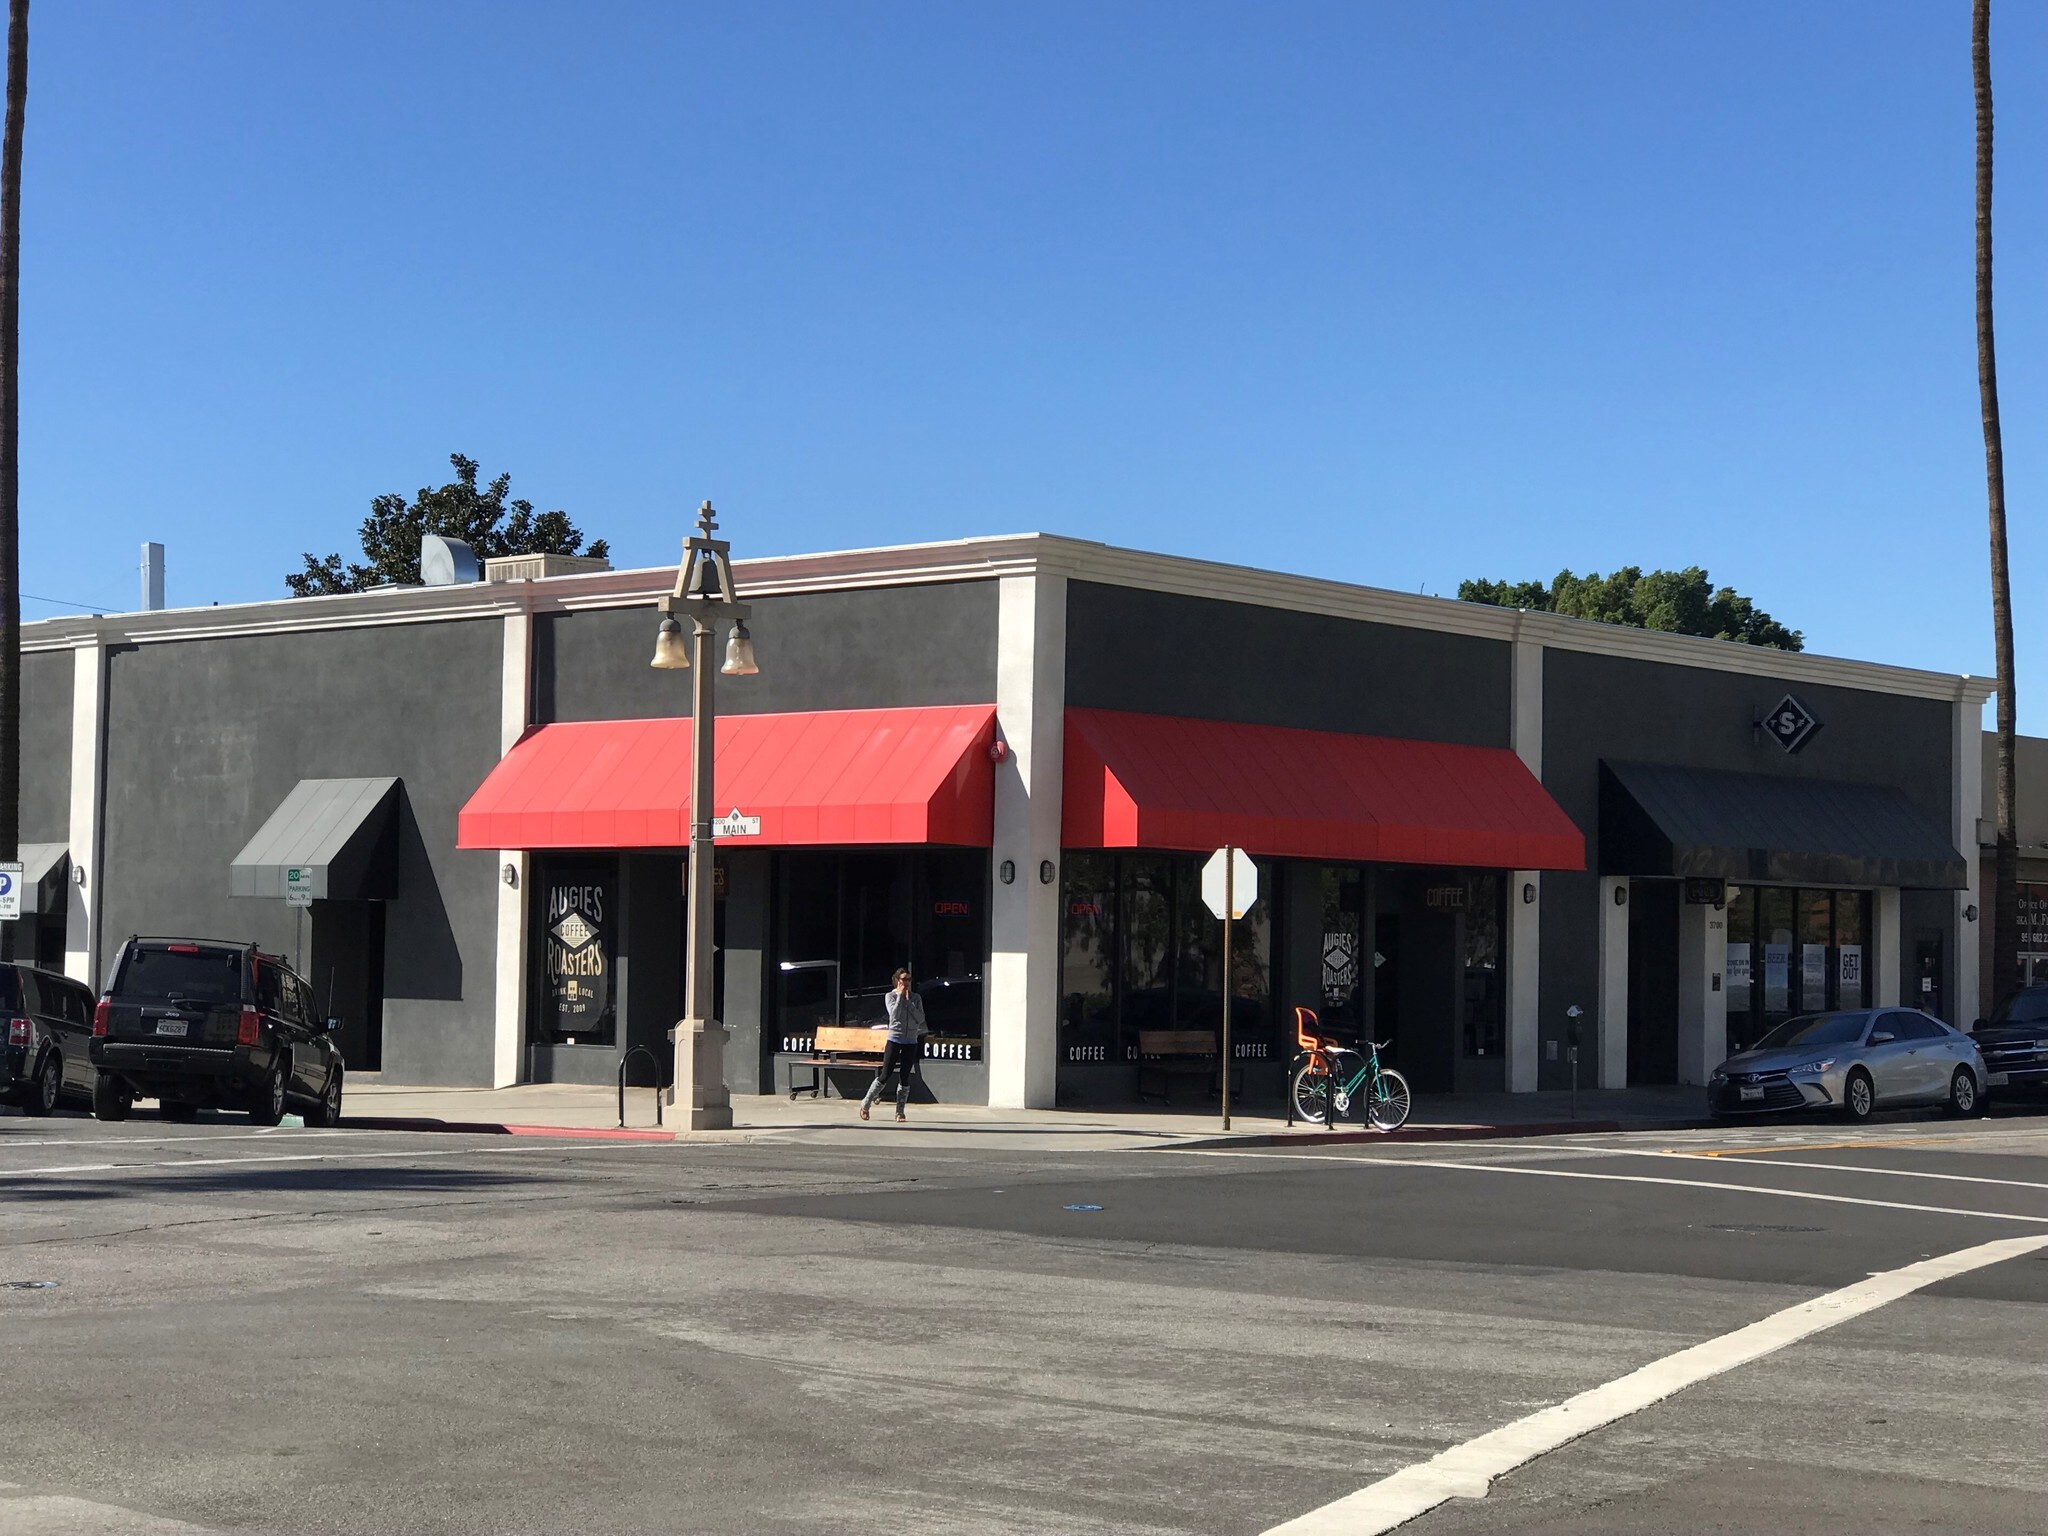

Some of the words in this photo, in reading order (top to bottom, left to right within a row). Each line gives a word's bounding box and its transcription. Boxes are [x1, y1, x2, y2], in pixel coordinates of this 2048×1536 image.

[1778, 711, 1796, 735] S
[723, 825, 747, 835] MAIN
[0, 862, 22, 871] ARKING
[289, 871, 299, 880] 20
[1426, 887, 1463, 907] COFFEE
[548, 886, 603, 924] AUGIES
[934, 902, 969, 914] OPEN
[1071, 903, 1102, 915] OPEN
[560, 923, 588, 937] COFFEE
[1323, 932, 1352, 955] AUGIES
[547, 937, 602, 986] ROASTERS
[1843, 954, 1859, 967] GET
[1321, 963, 1352, 992] ROASTERS
[1842, 967, 1859, 980] OUT
[578, 987, 594, 999] LOCAL
[558, 1003, 570, 1013] EST.
[783, 1036, 817, 1052] COFF
[924, 1042, 971, 1060] COFFEE
[1235, 1043, 1267, 1058] COFFEE
[1069, 1046, 1105, 1061] COFFEE
